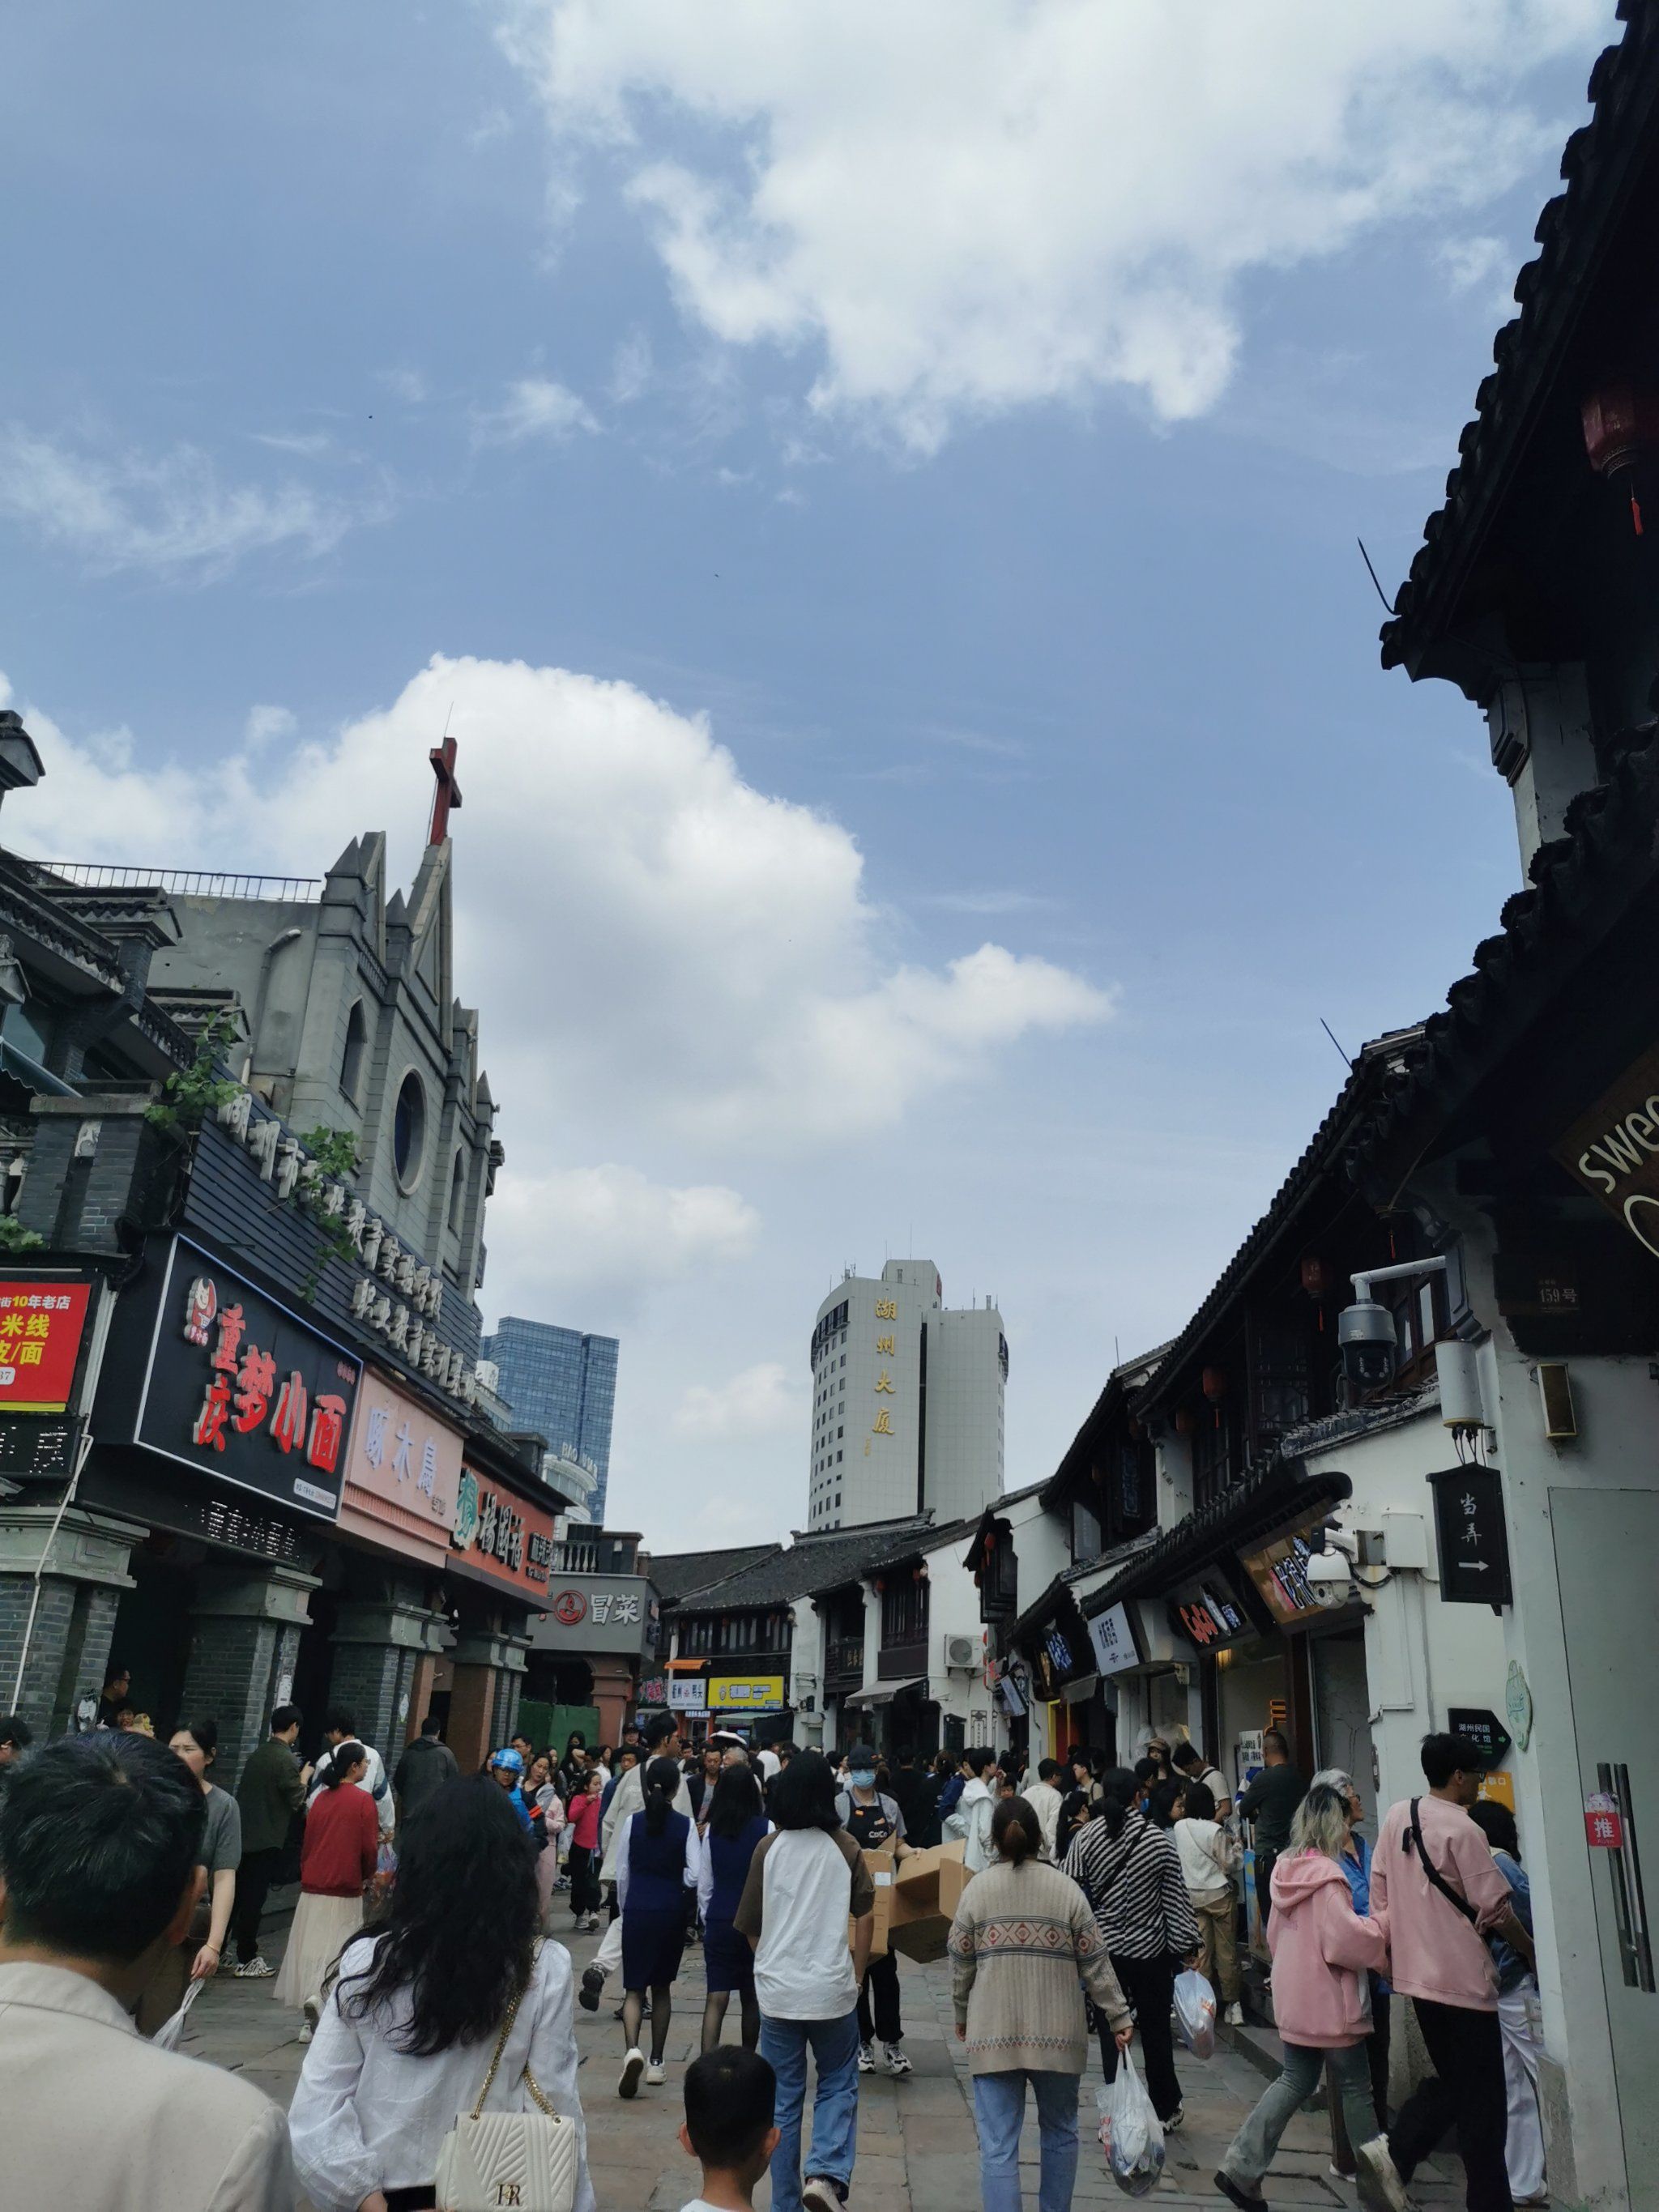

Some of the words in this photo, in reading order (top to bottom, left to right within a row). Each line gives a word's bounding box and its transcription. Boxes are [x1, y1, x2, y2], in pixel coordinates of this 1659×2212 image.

[0, 1313, 50, 1339] 米线
[872, 1297, 898, 1435] 湖州大厦
[1460, 1492, 1482, 1546] 当弄
[590, 1593, 642, 1625] 冒菜
[1459, 1723, 1491, 1733] 湖州民国
[1461, 1733, 1491, 1743] 化馆
[1594, 1818, 1614, 1839] 推
